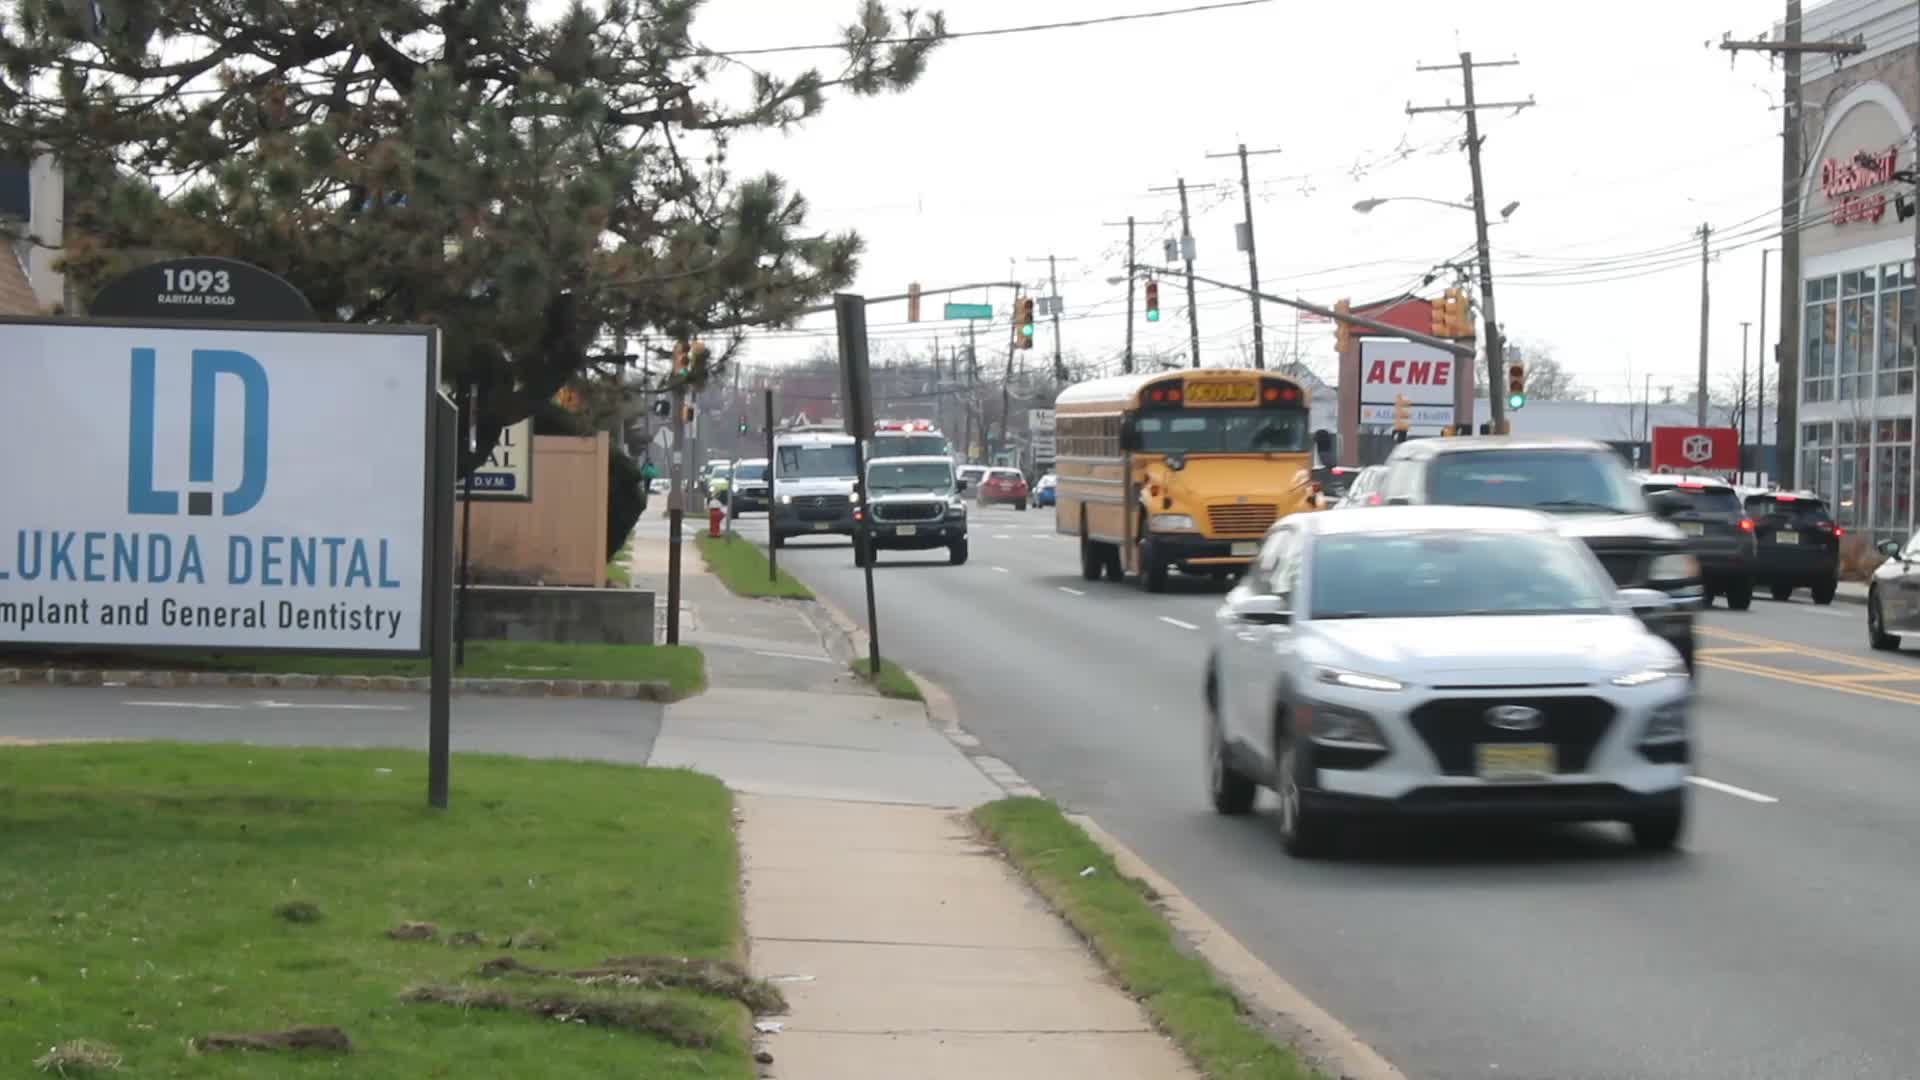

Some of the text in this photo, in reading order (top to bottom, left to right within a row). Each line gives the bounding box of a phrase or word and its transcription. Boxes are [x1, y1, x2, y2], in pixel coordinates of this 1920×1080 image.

[163, 268, 231, 293] 1093
[158, 294, 236, 305] RARITAN ROAD
[1366, 360, 1451, 386] ACME
[228, 535, 401, 588] DENTAL
[0, 595, 402, 639] mplant and General Dentistry
